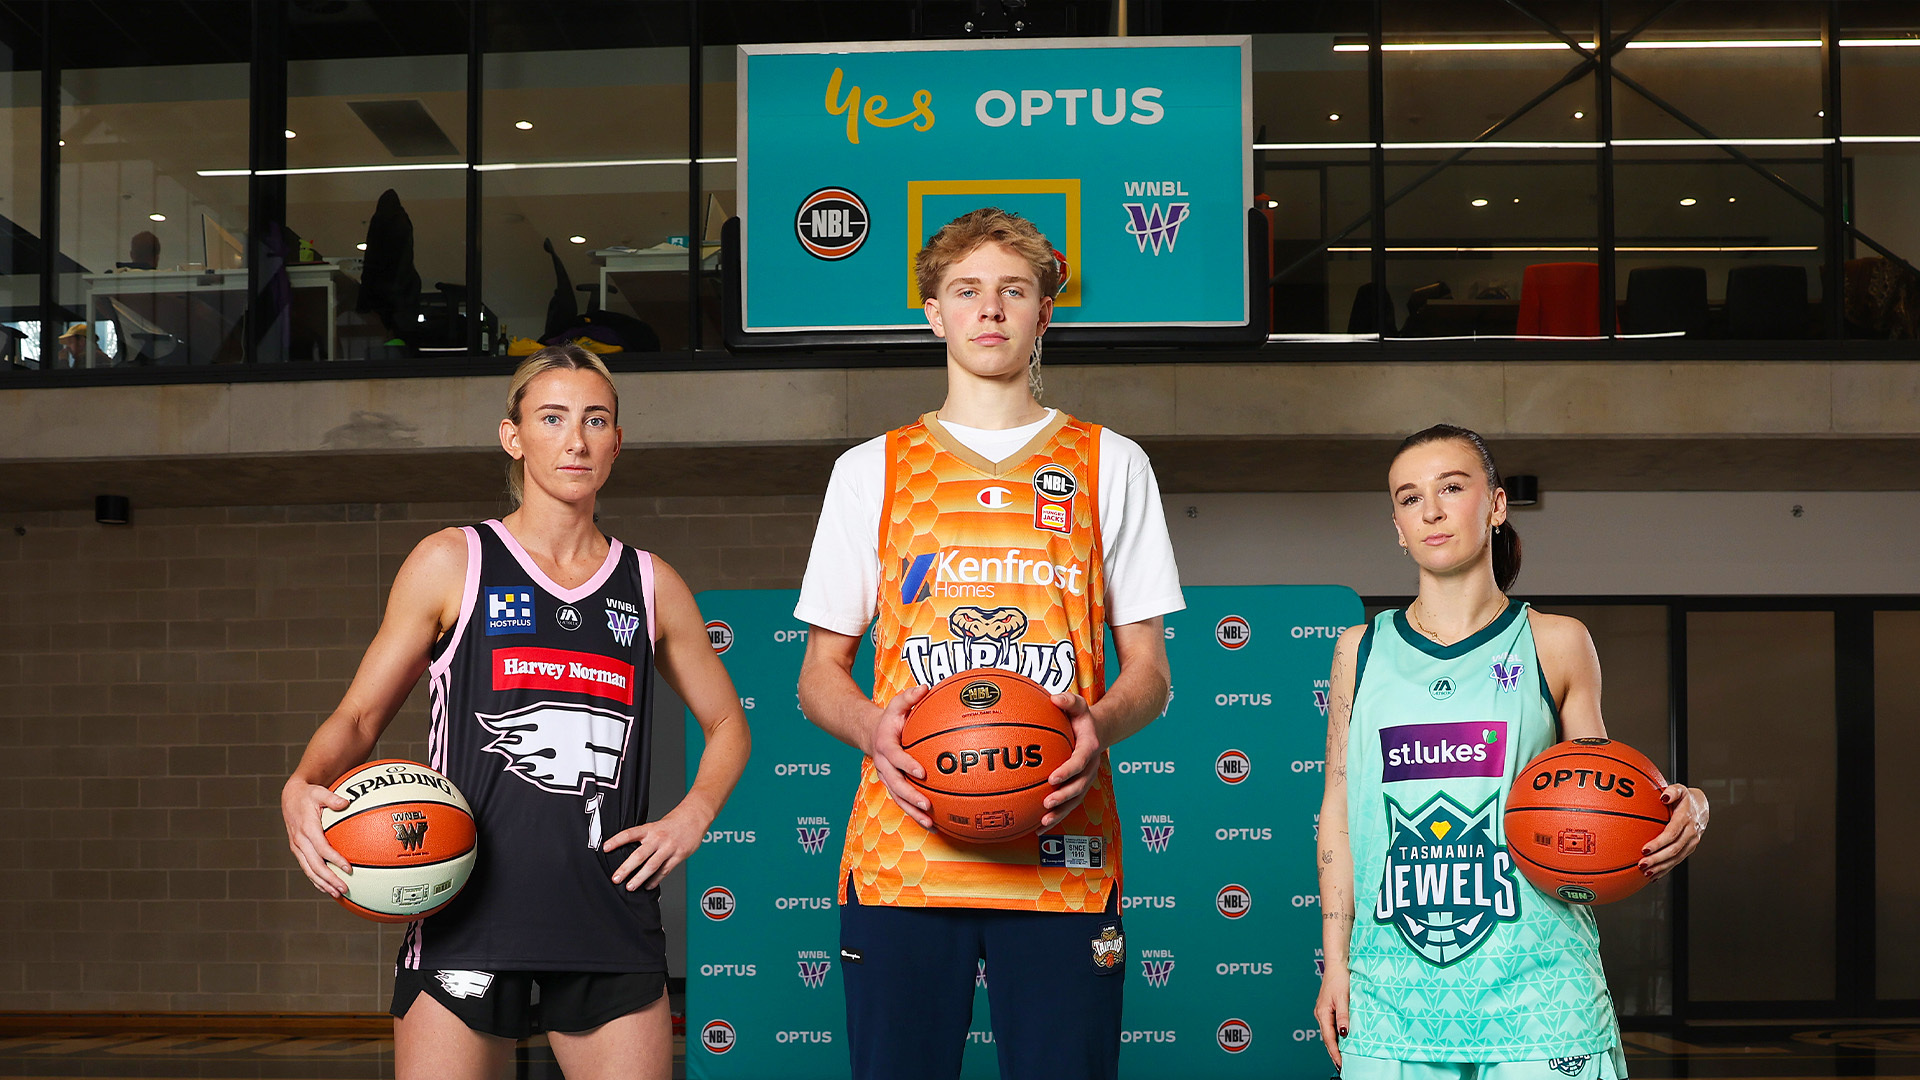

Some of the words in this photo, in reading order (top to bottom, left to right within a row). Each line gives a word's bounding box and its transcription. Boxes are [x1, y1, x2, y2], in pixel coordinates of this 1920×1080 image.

[975, 87, 1165, 127] OPTUS
[1124, 181, 1189, 197] WNBL
[811, 209, 853, 239] NBL
[1042, 474, 1067, 492] NBL
[936, 549, 1082, 594] Kenfrost
[935, 581, 996, 599] Homes
[606, 597, 638, 615] WNBL
[490, 619, 531, 628] HOSTPLUS
[774, 630, 808, 642] OPT
[1223, 626, 1243, 639] NBL
[901, 635, 1076, 695] TAIPANS
[503, 658, 566, 681] Harvey
[568, 661, 626, 690] Norman
[1313, 679, 1330, 688] WN
[969, 687, 993, 700] NBL
[1215, 693, 1272, 706] OPTUS
[935, 743, 1044, 775] OPTUS
[1388, 739, 1488, 768] st.lukes
[774, 763, 831, 776] OPTUS
[1118, 761, 1175, 774] OPTUS
[1223, 760, 1243, 773] NBL
[1291, 761, 1325, 773] OPT
[345, 772, 453, 802] SPALDING
[1532, 769, 1636, 798] OPTUS
[392, 811, 427, 822] WNBL
[797, 816, 830, 825] WNBL
[1141, 815, 1174, 823] WNBL
[702, 831, 756, 843] OPTUS
[1215, 828, 1272, 840] OPTUS
[1068, 844, 1086, 852] SINCE
[1399, 843, 1484, 861] TASMANIA
[1376, 851, 1515, 919] JEWELS
[708, 896, 728, 910] NBL
[775, 897, 832, 910] OPTUS
[1121, 896, 1176, 909] OPTUS
[1224, 894, 1243, 909] NBL
[1292, 895, 1321, 907] OPT
[798, 950, 831, 959] WNBL
[1142, 949, 1174, 958] WNBL
[701, 964, 757, 977] OPTUS
[1216, 963, 1273, 975] OPTUS
[709, 1029, 728, 1044] NBL
[776, 1031, 832, 1044] OPTUS
[1120, 1030, 1176, 1043] OPTUS
[1224, 1029, 1244, 1043] NBL
